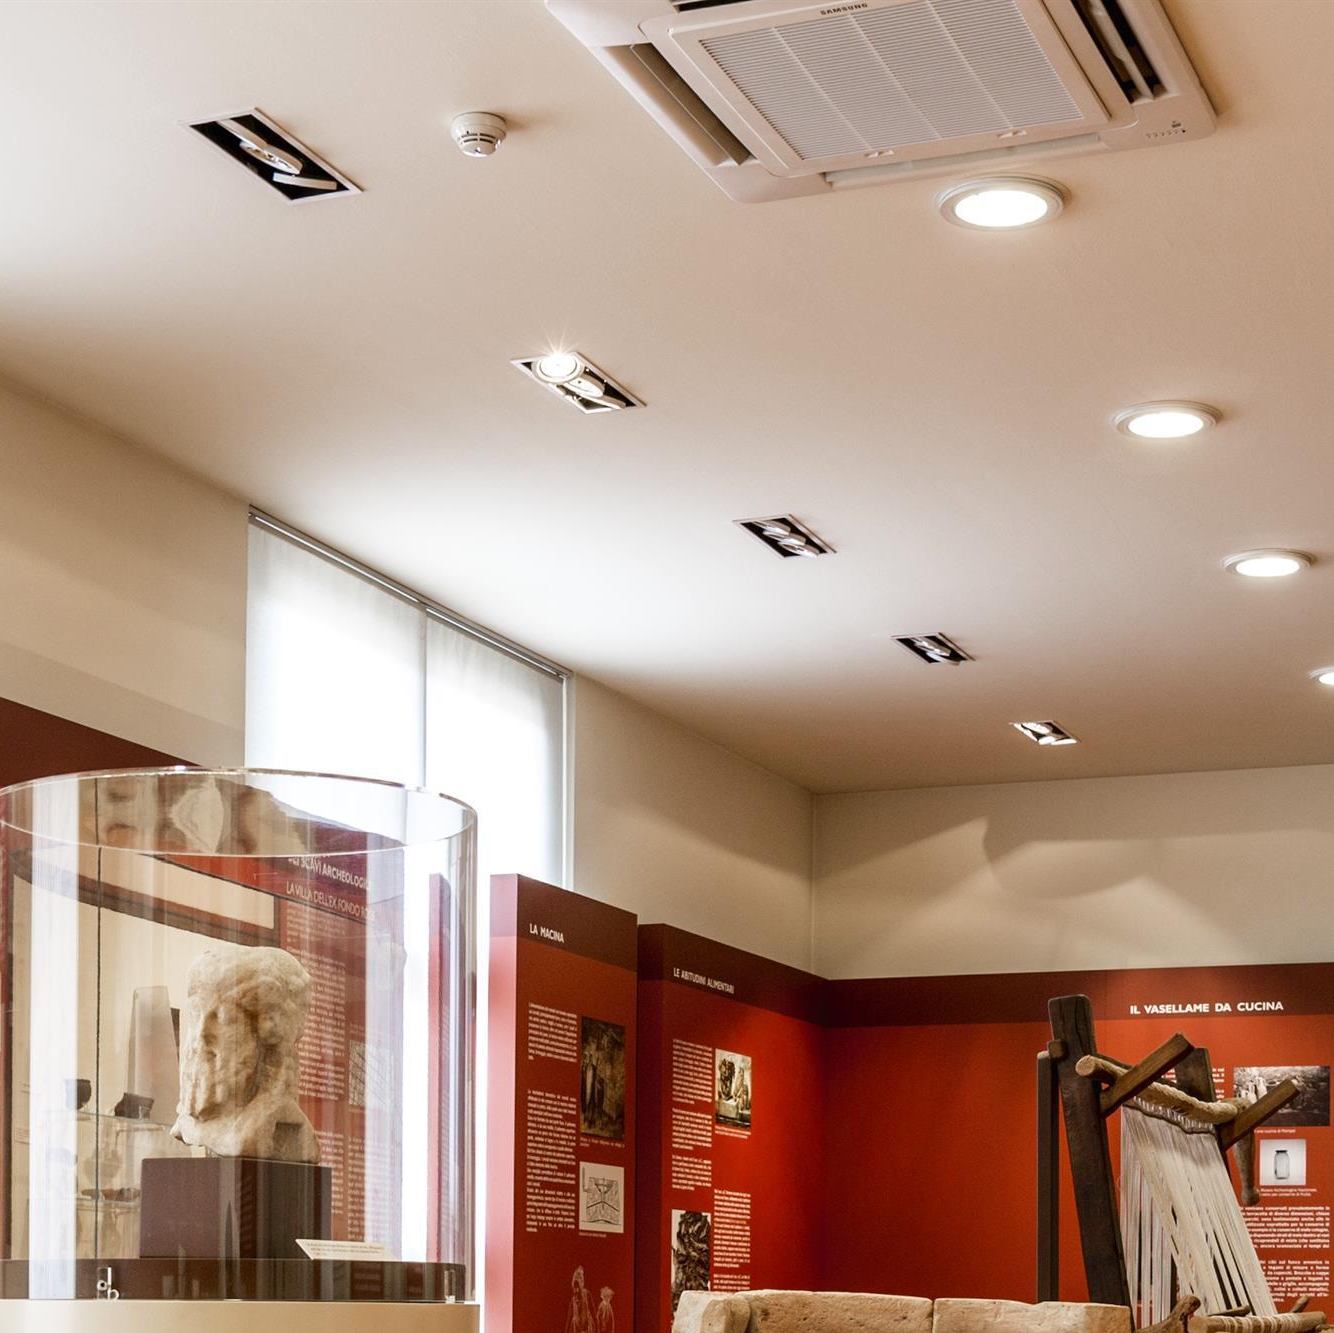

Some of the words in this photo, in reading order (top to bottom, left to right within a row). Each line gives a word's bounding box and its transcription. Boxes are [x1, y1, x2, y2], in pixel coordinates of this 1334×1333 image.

[286, 881, 295, 895] LA
[295, 883, 312, 901] VILLA
[314, 890, 337, 909] DELL'EX
[337, 899, 360, 917] FONDO
[529, 923, 538, 935] LA
[540, 926, 565, 943] MACINA
[673, 967, 681, 979] LE
[681, 970, 706, 985] ABITUDINI
[707, 976, 734, 994] ALIMENTARI
[1130, 1005, 1141, 1014] IL
[1144, 1003, 1209, 1014] VASELLAME
[1215, 1003, 1232, 1012] DA
[1237, 1001, 1284, 1012] CUCINA
